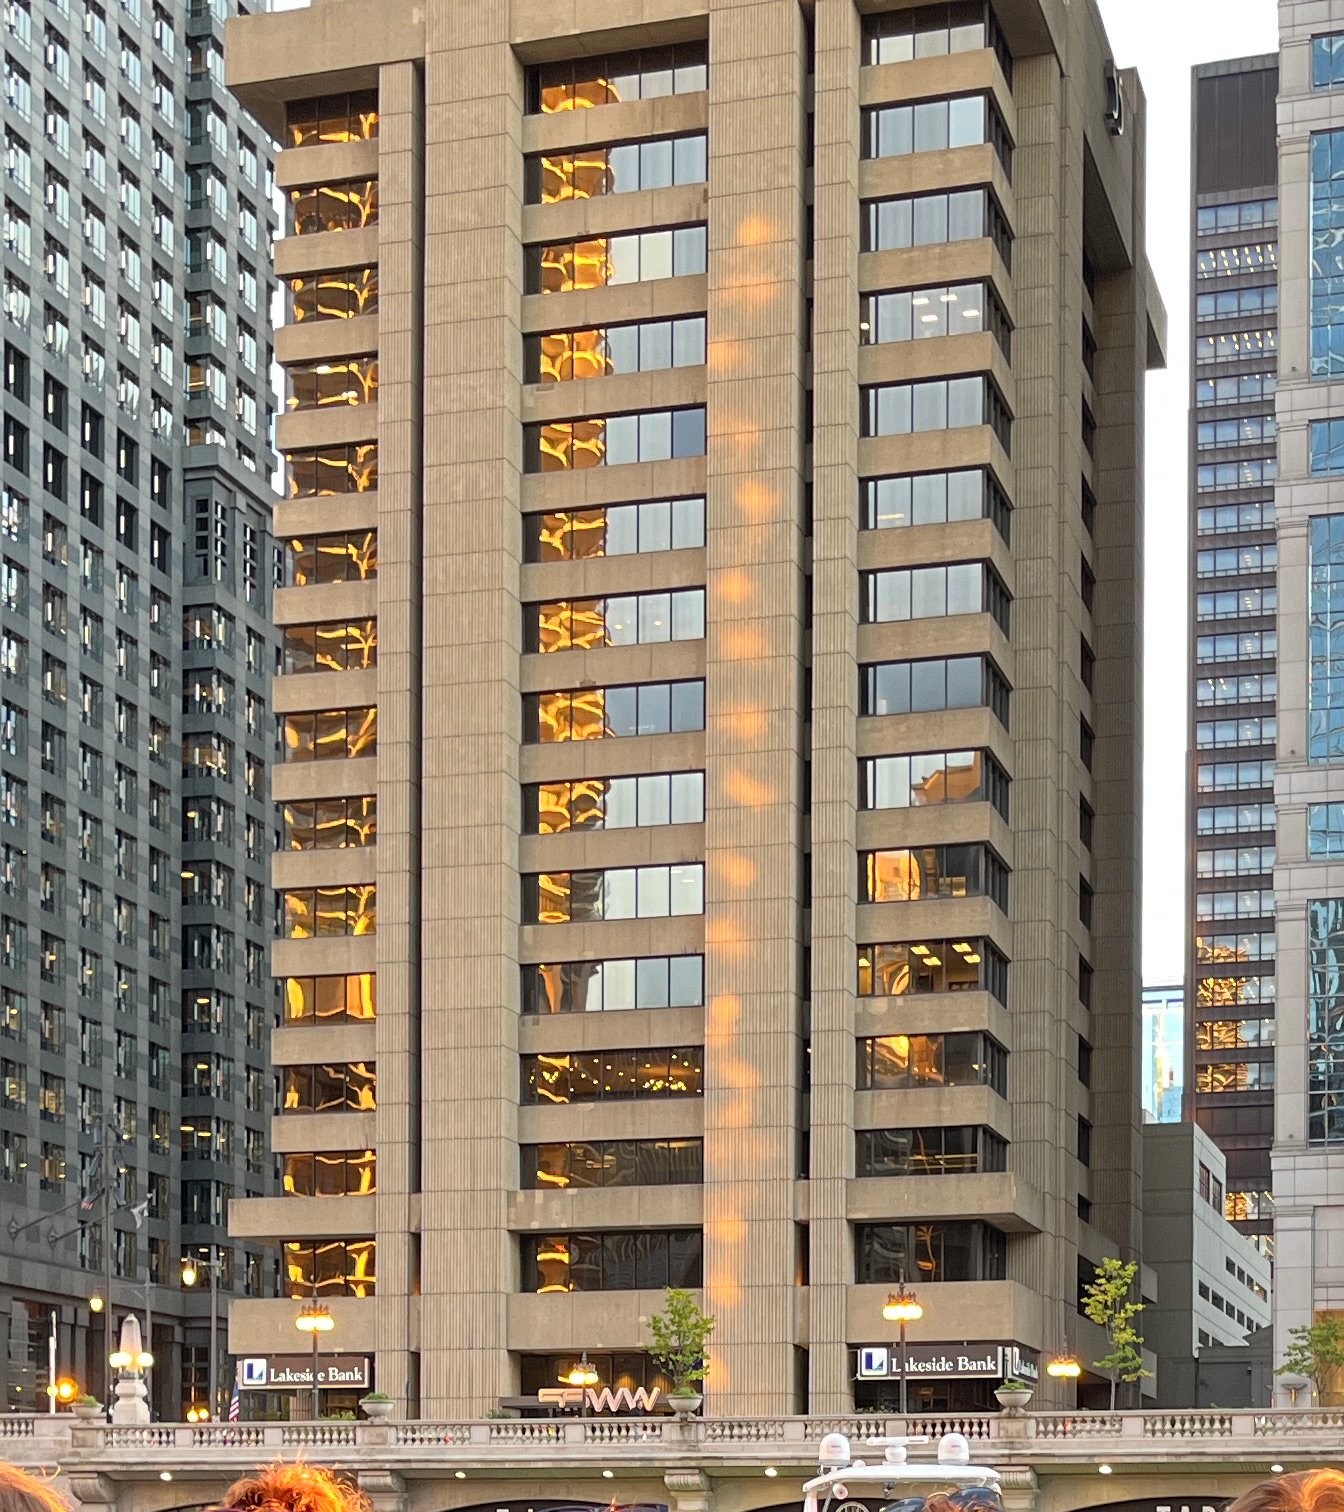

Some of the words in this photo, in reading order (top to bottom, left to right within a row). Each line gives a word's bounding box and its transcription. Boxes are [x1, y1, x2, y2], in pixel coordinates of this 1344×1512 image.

[957, 1356, 996, 1371] Bank
[270, 1368, 325, 1382] Lakesie
[328, 1367, 362, 1381] Bank
